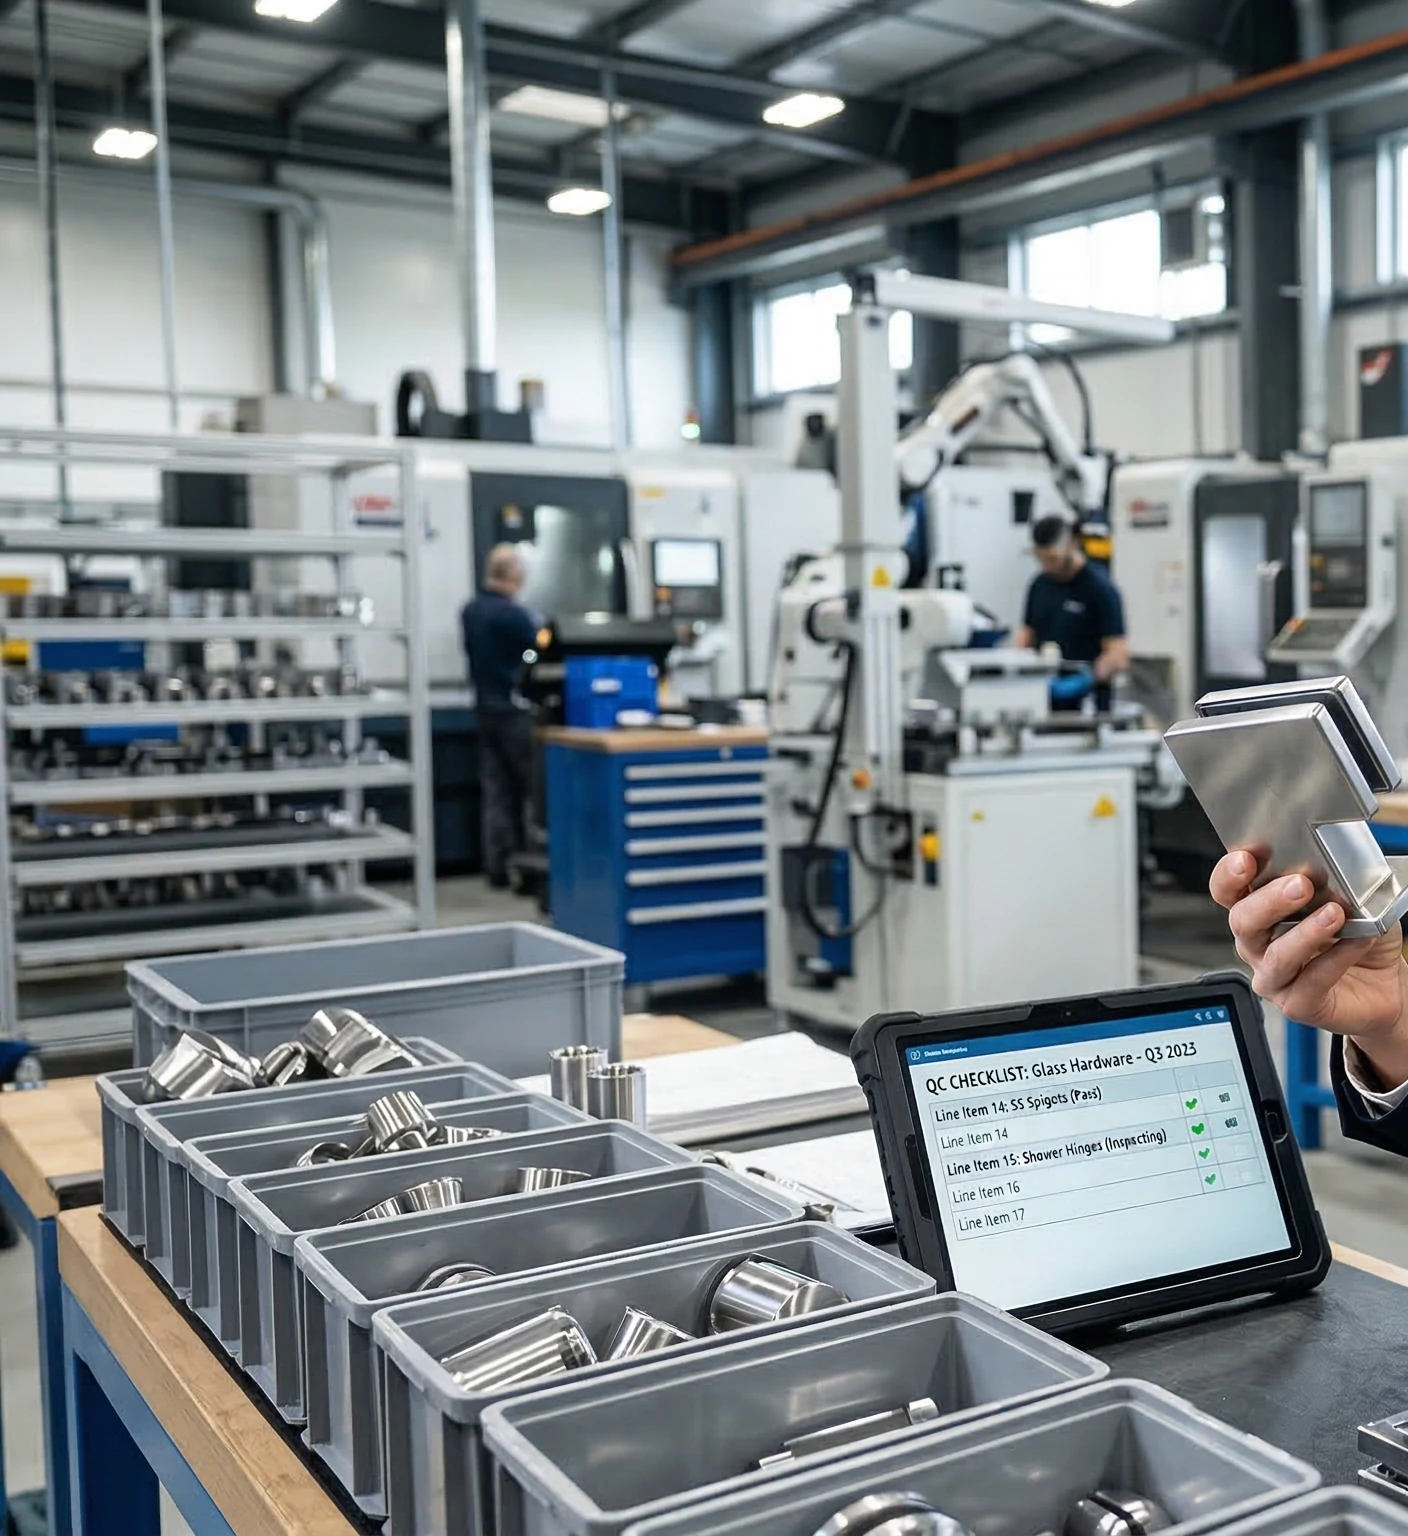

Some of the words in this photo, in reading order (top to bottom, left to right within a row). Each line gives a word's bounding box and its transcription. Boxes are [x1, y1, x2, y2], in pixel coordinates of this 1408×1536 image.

[926, 1078, 947, 1096] QC
[949, 1065, 1029, 1091] CHECKLIST:
[1031, 1062, 1068, 1078] Glass
[1069, 1053, 1134, 1074] Hardware
[1144, 1047, 1163, 1064] Q3
[1167, 1041, 1197, 1059] 2023
[935, 1108, 960, 1123] Line
[962, 1104, 989, 1120] Item
[991, 1101, 1009, 1115] 14:
[1011, 1098, 1025, 1112] SS
[940, 1134, 965, 1150] Line
[967, 1130, 993, 1146] Item
[995, 1127, 1009, 1141] 14
[946, 1162, 971, 1176] Line
[973, 1157, 1000, 1173] Item
[1003, 1153, 1021, 1168] 15:
[1065, 1140, 1103, 1158] Hinges
[952, 1189, 977, 1204] Line
[978, 1185, 1005, 1199] Item
[1007, 1180, 1021, 1195] 16
[958, 1217, 983, 1232] Line
[1012, 1207, 1026, 1222] 17
